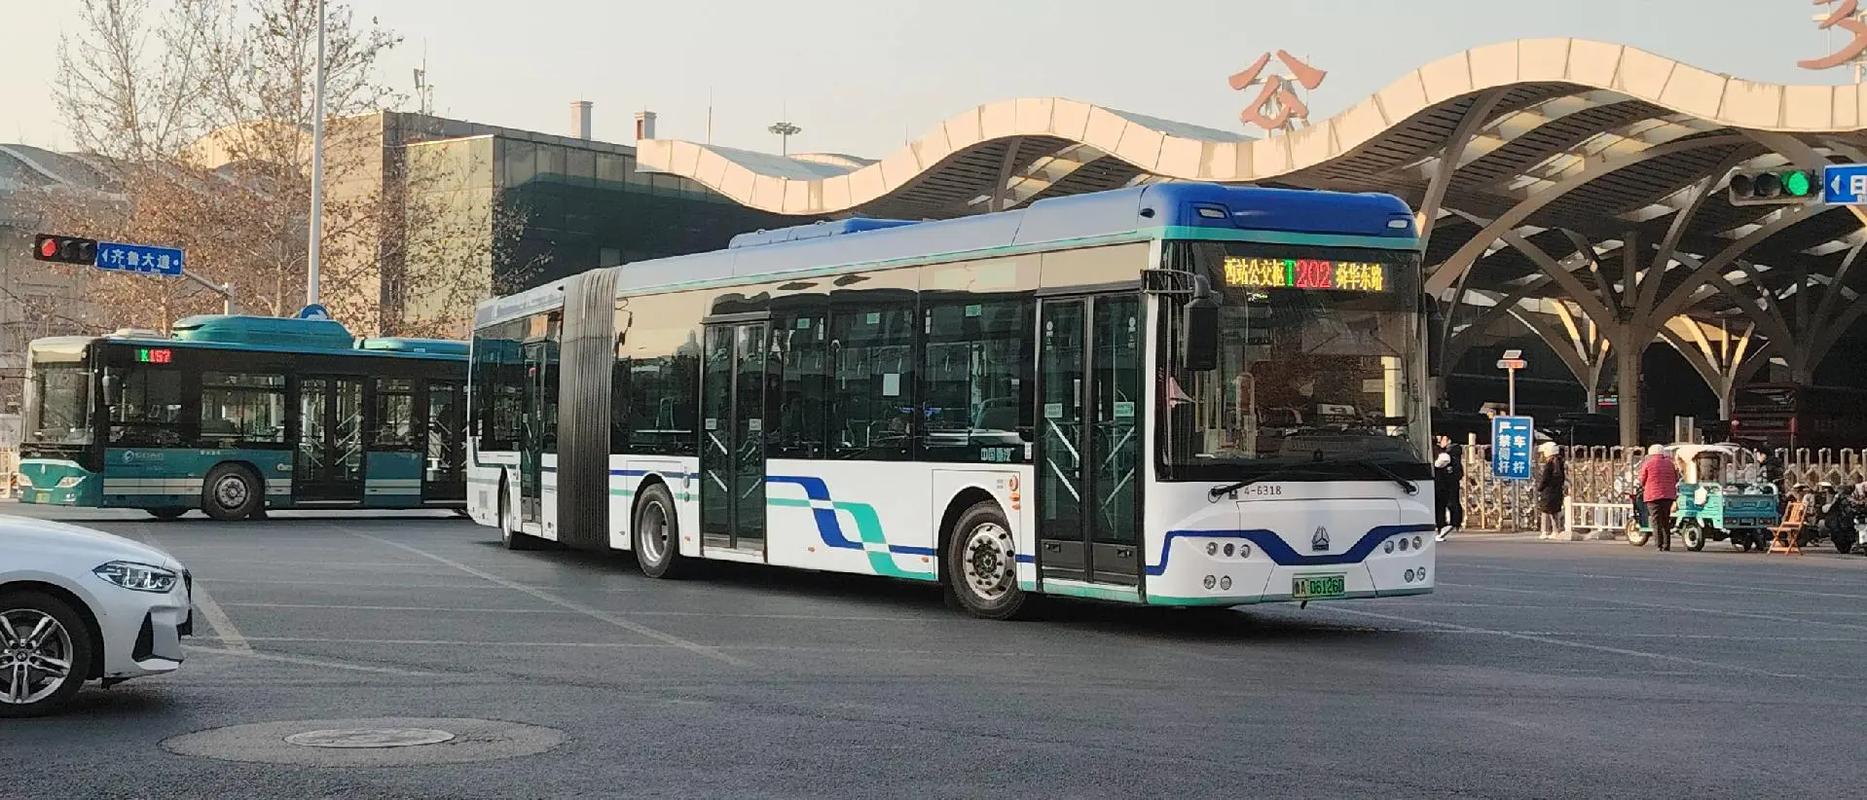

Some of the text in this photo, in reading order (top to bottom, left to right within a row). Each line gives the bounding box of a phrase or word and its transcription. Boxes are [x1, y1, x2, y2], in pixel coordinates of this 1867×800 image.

[1228, 49, 1328, 129] 公
[110, 248, 170, 269] 齐鲁大道
[1284, 259, 1331, 288] T202
[1513, 425, 1526, 473] 一车一杆
[1244, 485, 1282, 495] 4-6318
